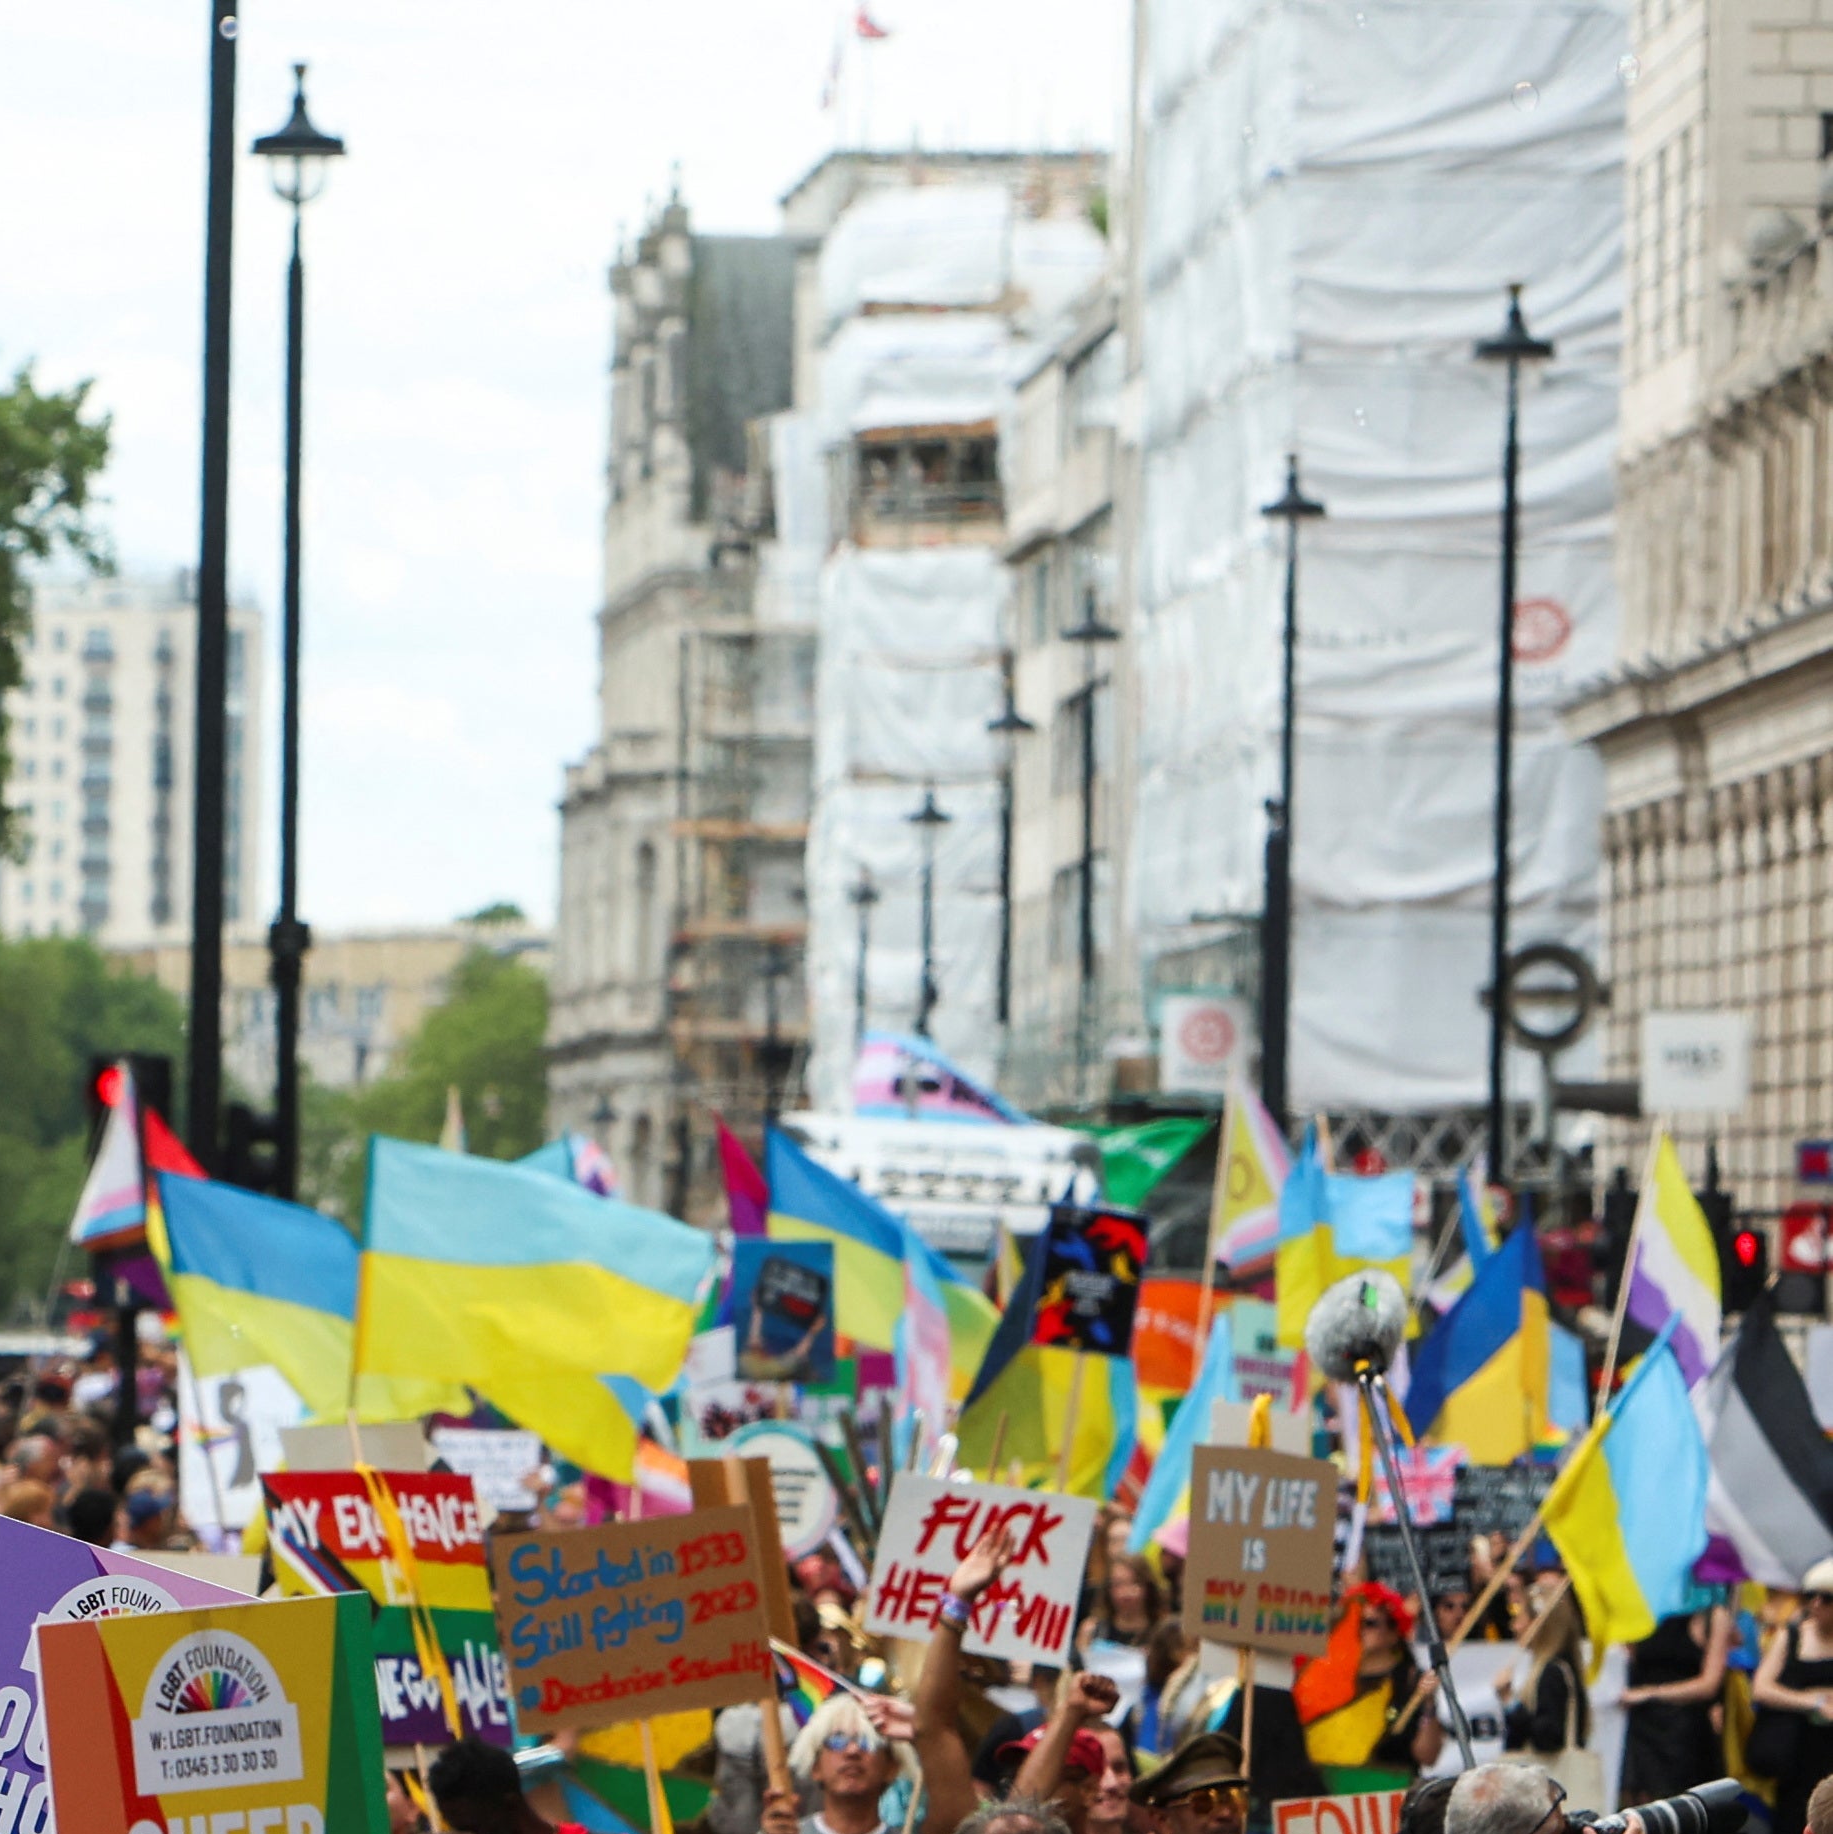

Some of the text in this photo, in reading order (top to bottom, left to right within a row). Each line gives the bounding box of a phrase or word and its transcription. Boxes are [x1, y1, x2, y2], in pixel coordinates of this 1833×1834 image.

[272, 1499, 321, 1550] MY
[1206, 1468, 1319, 1530] MY LIFE
[509, 1543, 644, 1607] Started
[1242, 1537, 1267, 1572] IS
[510, 1612, 582, 1670] Still
[155, 1646, 270, 1714] LGBT FOUNDATION
[175, 1757, 208, 1778] 0345
[212, 1756, 219, 1774] 3
[223, 1754, 238, 1773] 30
[241, 1752, 257, 1771] 30
[261, 1750, 277, 1769] 30
